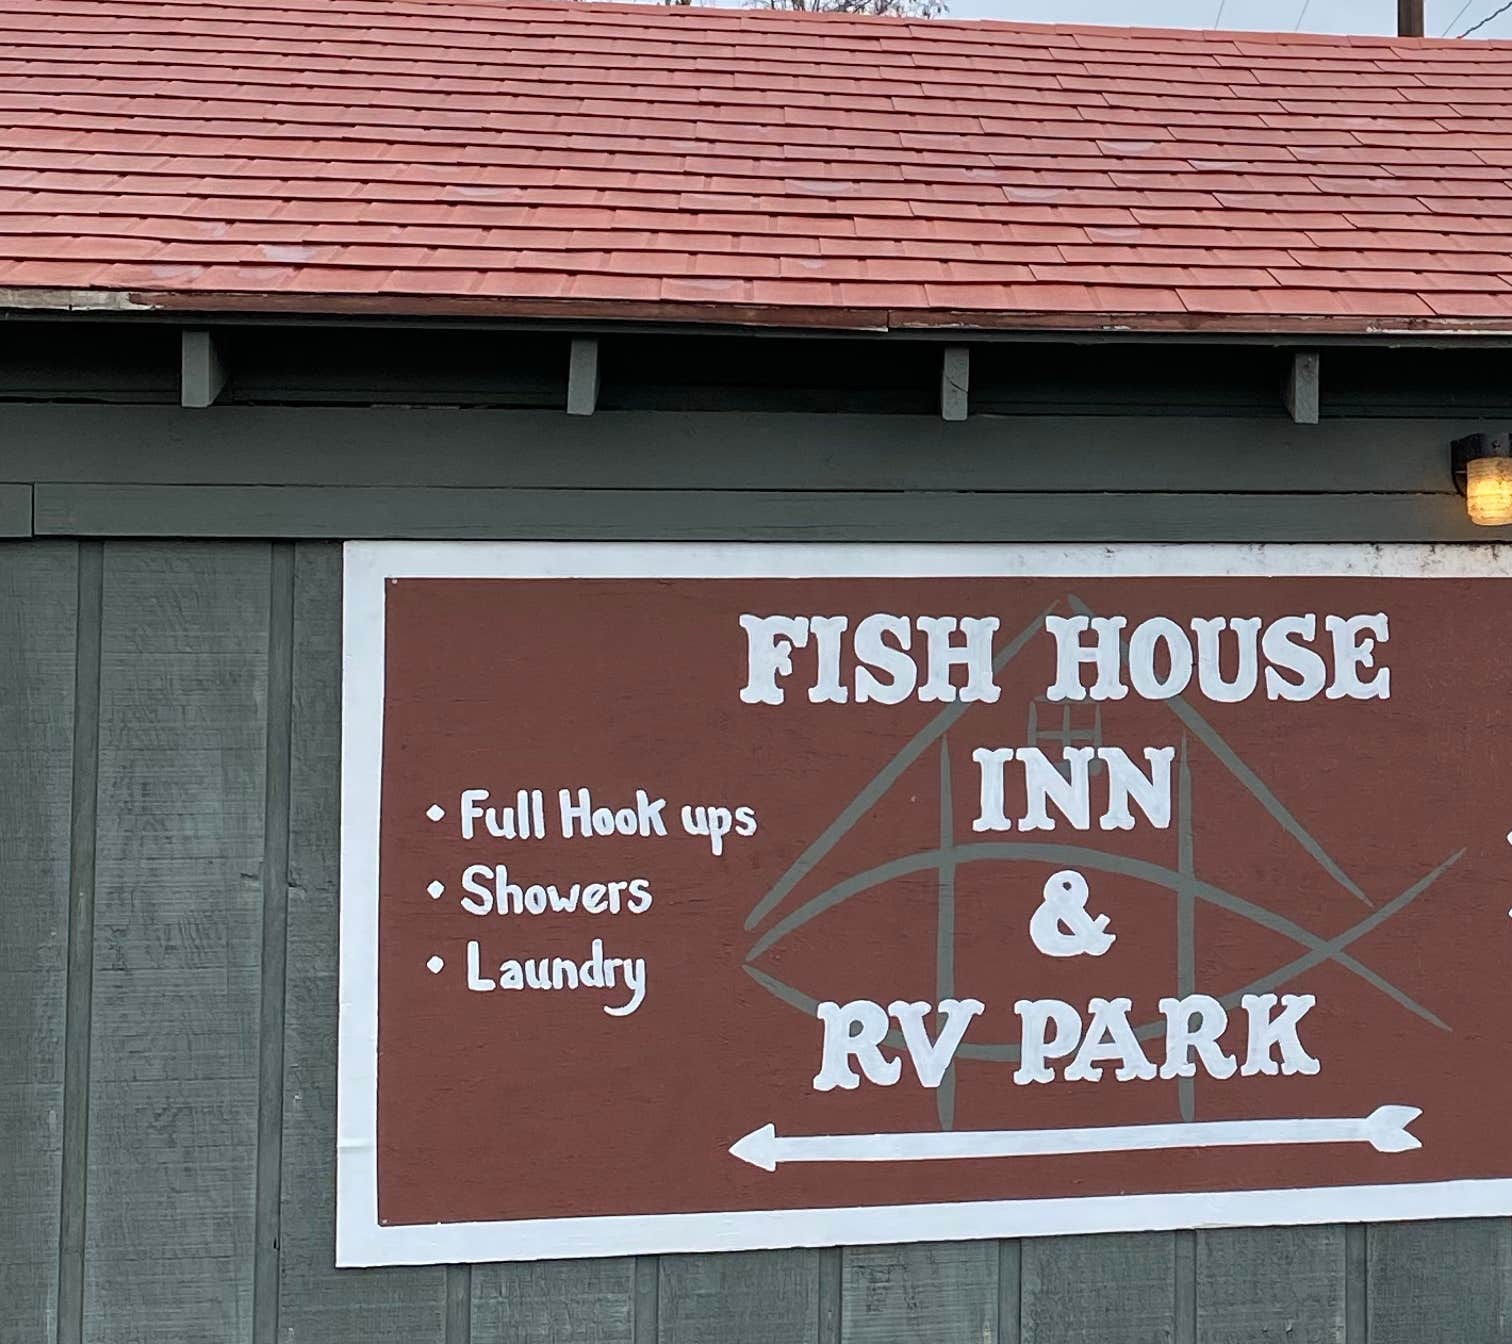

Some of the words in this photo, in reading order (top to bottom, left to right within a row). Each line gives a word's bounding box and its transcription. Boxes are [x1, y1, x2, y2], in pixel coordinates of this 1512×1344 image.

[739, 613, 1002, 705] FISH
[1045, 612, 1391, 703] HOUSE
[460, 789, 546, 840] Full
[558, 787, 668, 839] Hook
[681, 805, 758, 856] ups
[972, 746, 1176, 832] INN
[460, 864, 653, 916] Showers
[1029, 869, 1117, 957] &
[467, 938, 646, 1017] Laundry
[812, 998, 986, 1092] RV
[1013, 992, 1321, 1086] PARK
